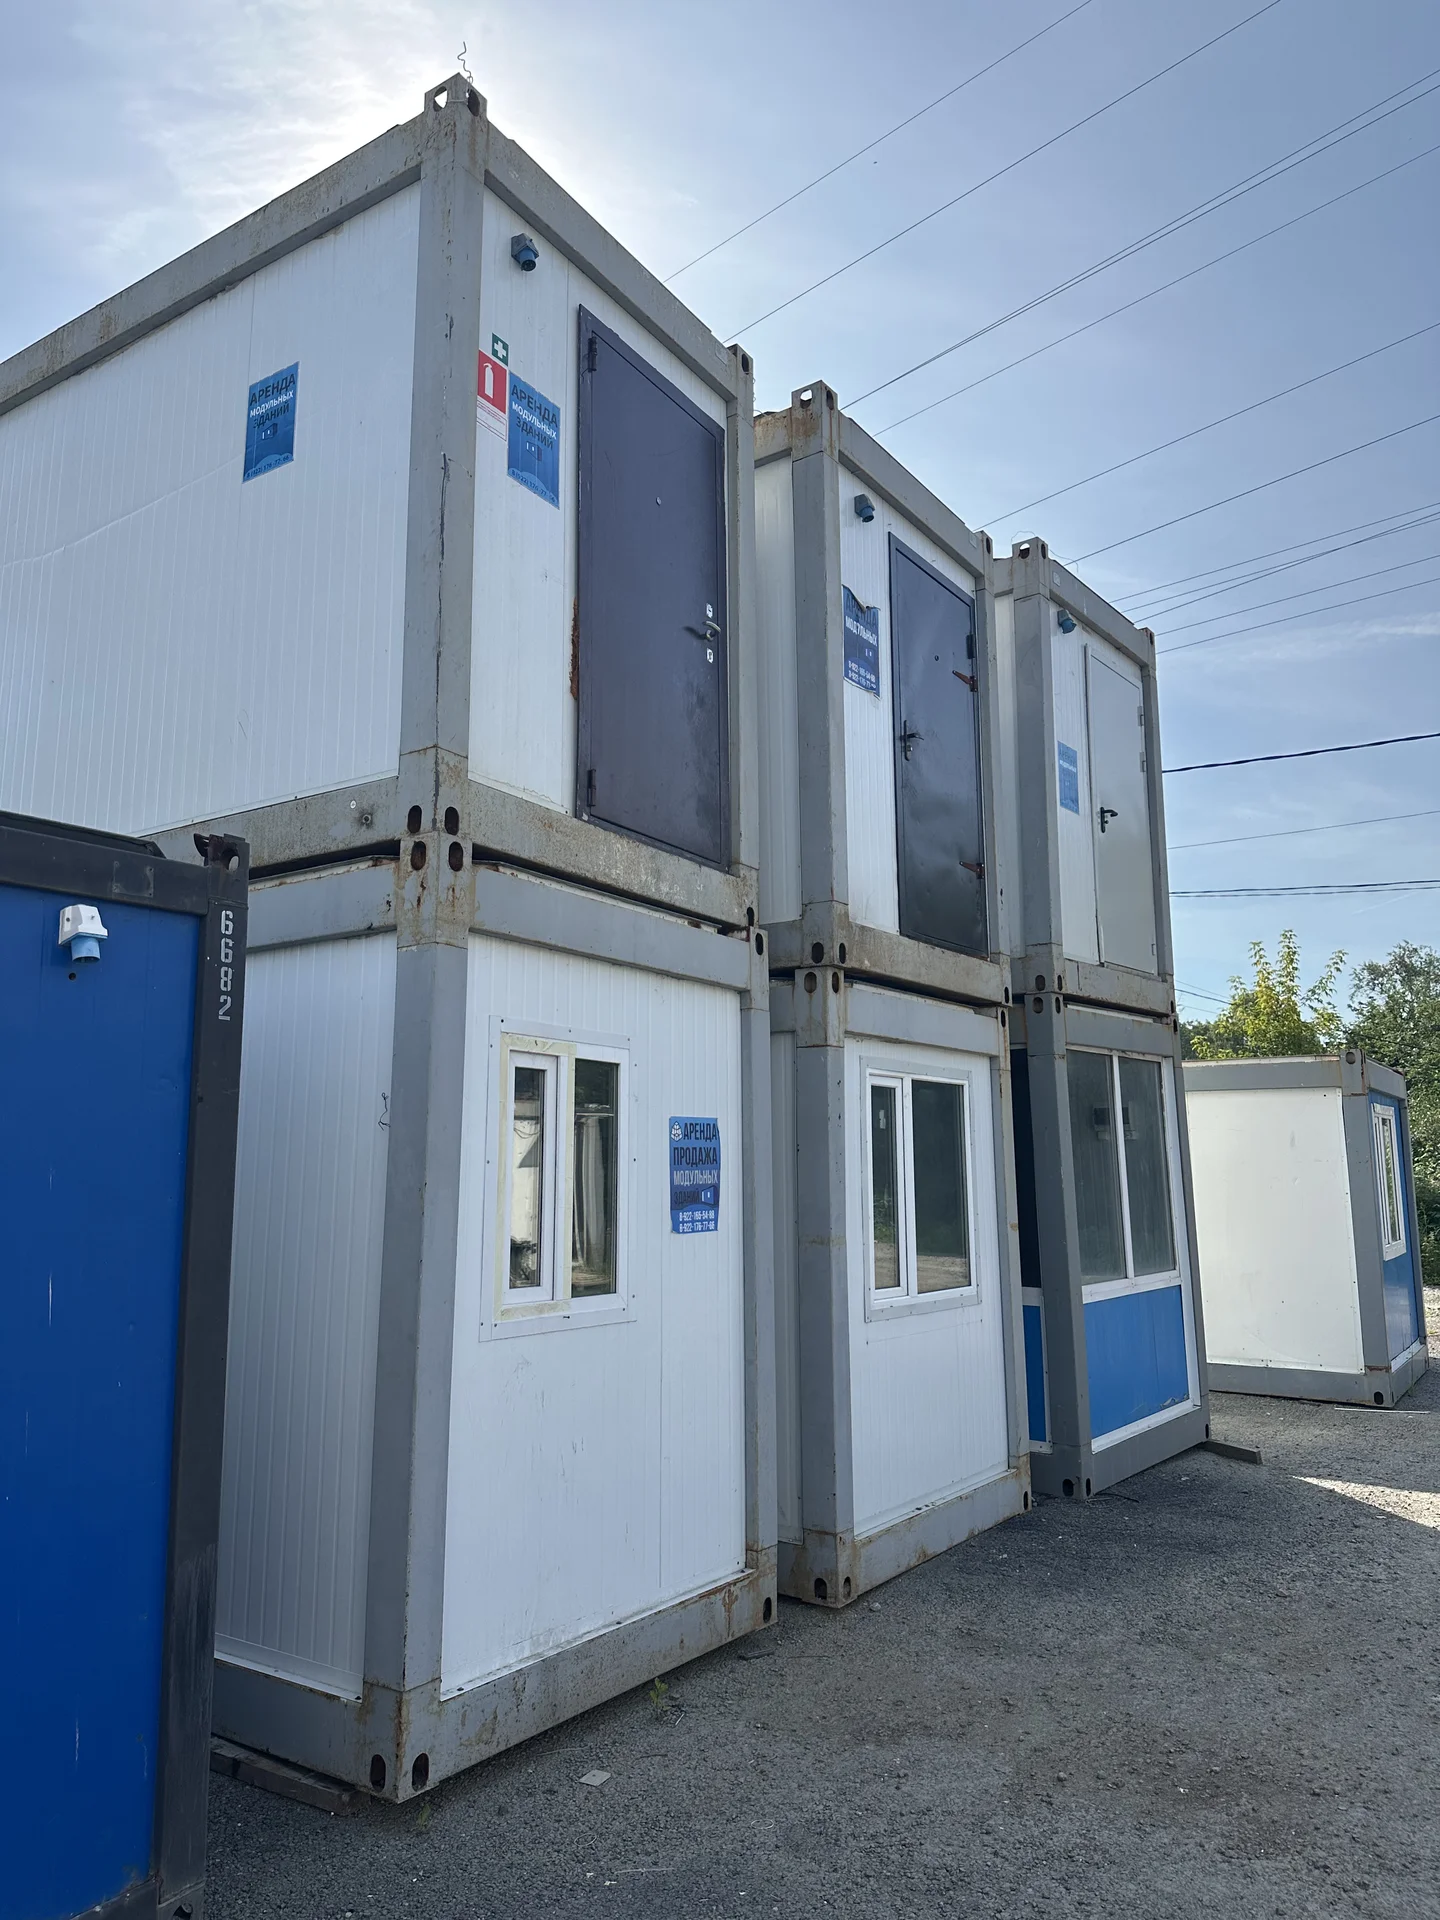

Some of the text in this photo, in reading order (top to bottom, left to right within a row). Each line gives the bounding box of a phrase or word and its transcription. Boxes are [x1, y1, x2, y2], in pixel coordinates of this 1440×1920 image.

[250, 373, 295, 406] АРЕНДА
[250, 390, 294, 418] МОДУЛЬНЫХ
[253, 401, 290, 429] ЗДАНИЙ
[511, 384, 558, 428] АРЕНДА
[512, 401, 557, 440] МОДУЛЬНЫХ
[516, 416, 553, 449] ЗДАНИЙ
[845, 615, 878, 646] МОДУЛЬНЫХ
[218, 910, 234, 1021] 6682
[683, 1122, 719, 1142] АРЕНДА
[673, 1147, 718, 1167] ПРОДАЖА
[674, 1169, 718, 1186] МОДУЛЬНЫХ
[674, 1188, 700, 1205] ЗДАНИЙ
